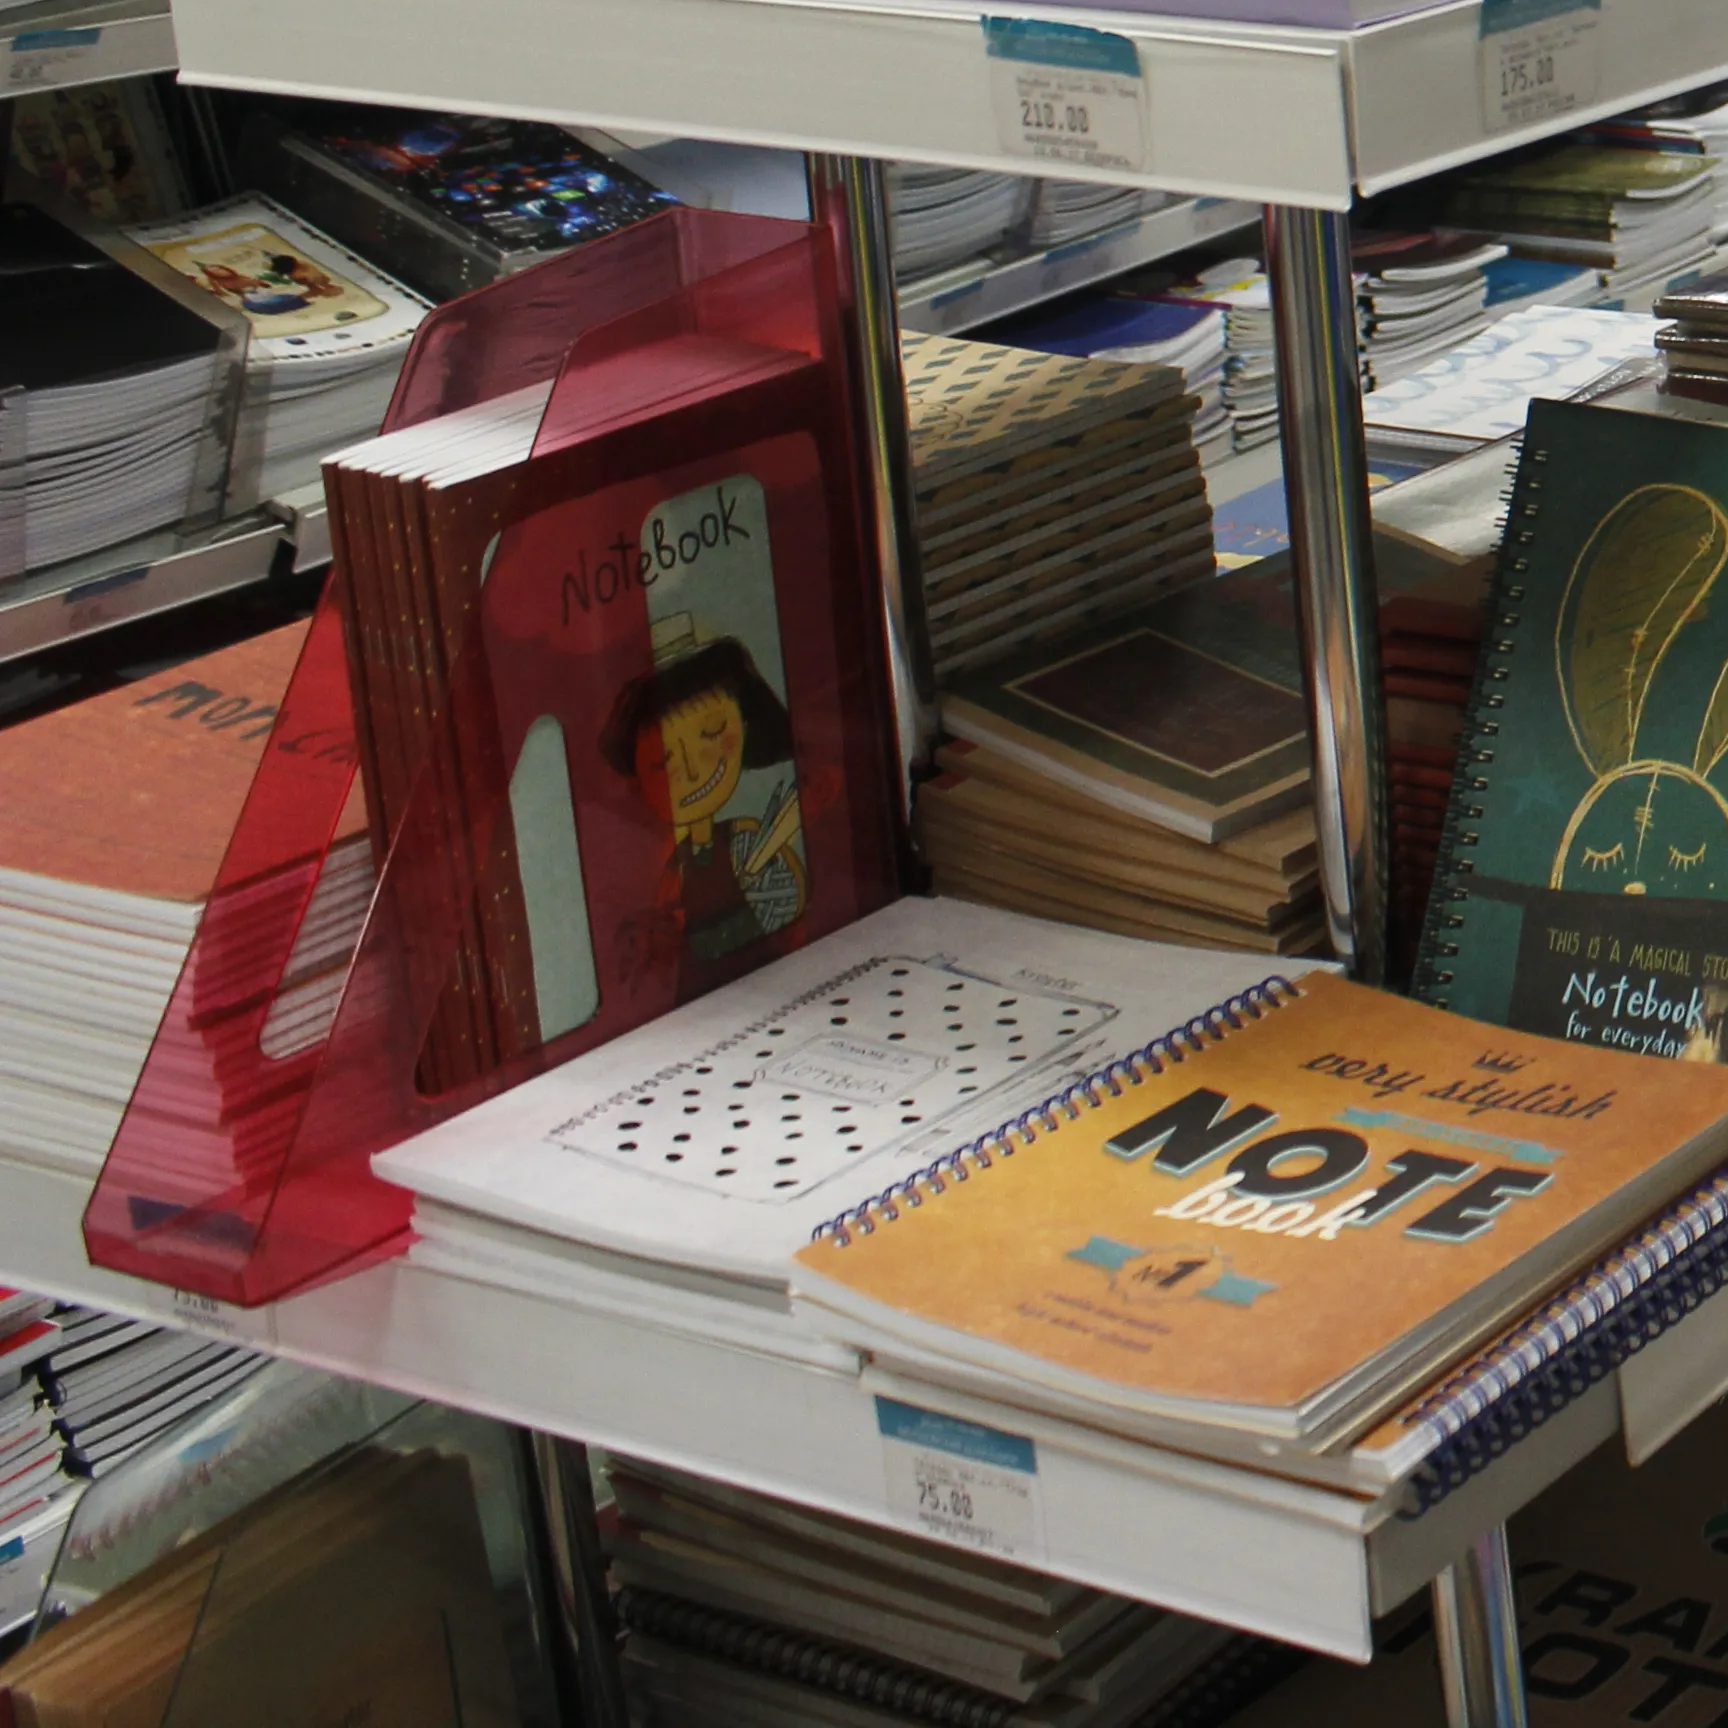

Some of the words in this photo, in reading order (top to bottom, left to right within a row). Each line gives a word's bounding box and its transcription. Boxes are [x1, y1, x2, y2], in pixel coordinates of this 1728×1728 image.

[1501, 56, 1554, 97] 175.00
[1020, 100, 1090, 133] 210.00
[561, 485, 751, 627] Notebook
[1548, 927, 1581, 956] THIS
[1587, 936, 1602, 960] IS
[1628, 942, 1694, 978] MAGICAL
[1561, 968, 1706, 1031] Notebook
[1565, 1009, 1593, 1039] for
[1601, 1024, 1691, 1060] everyday
[1300, 1049, 1425, 1095] very
[1426, 1077, 1619, 1121] stylish
[1104, 1086, 1557, 1245] NOTE
[1152, 1170, 1379, 1241] book
[917, 1481, 975, 1520] 75.00
